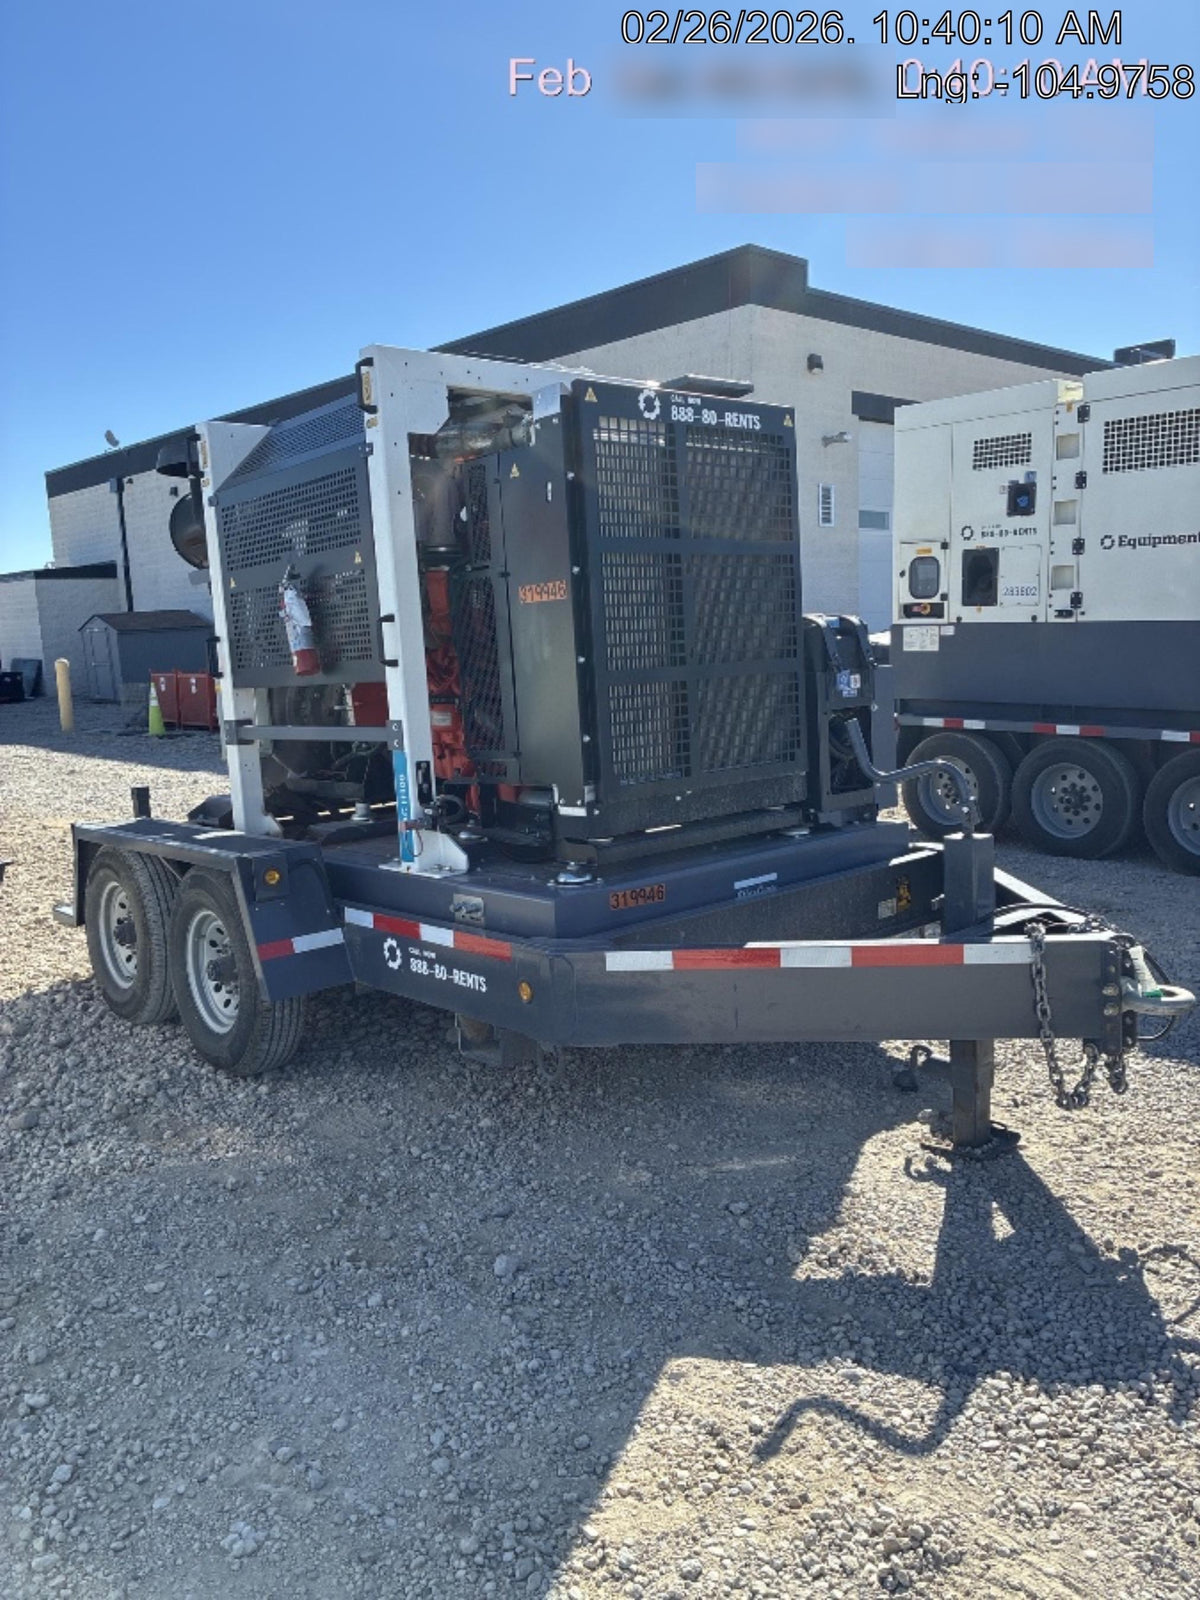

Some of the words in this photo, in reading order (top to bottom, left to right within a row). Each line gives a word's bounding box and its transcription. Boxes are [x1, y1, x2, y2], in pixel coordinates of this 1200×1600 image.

[671, 405, 762, 430] 888-80-RENTS
[610, 884, 664, 910] 319946
[410, 958, 487, 992] 888-80-RENTS
